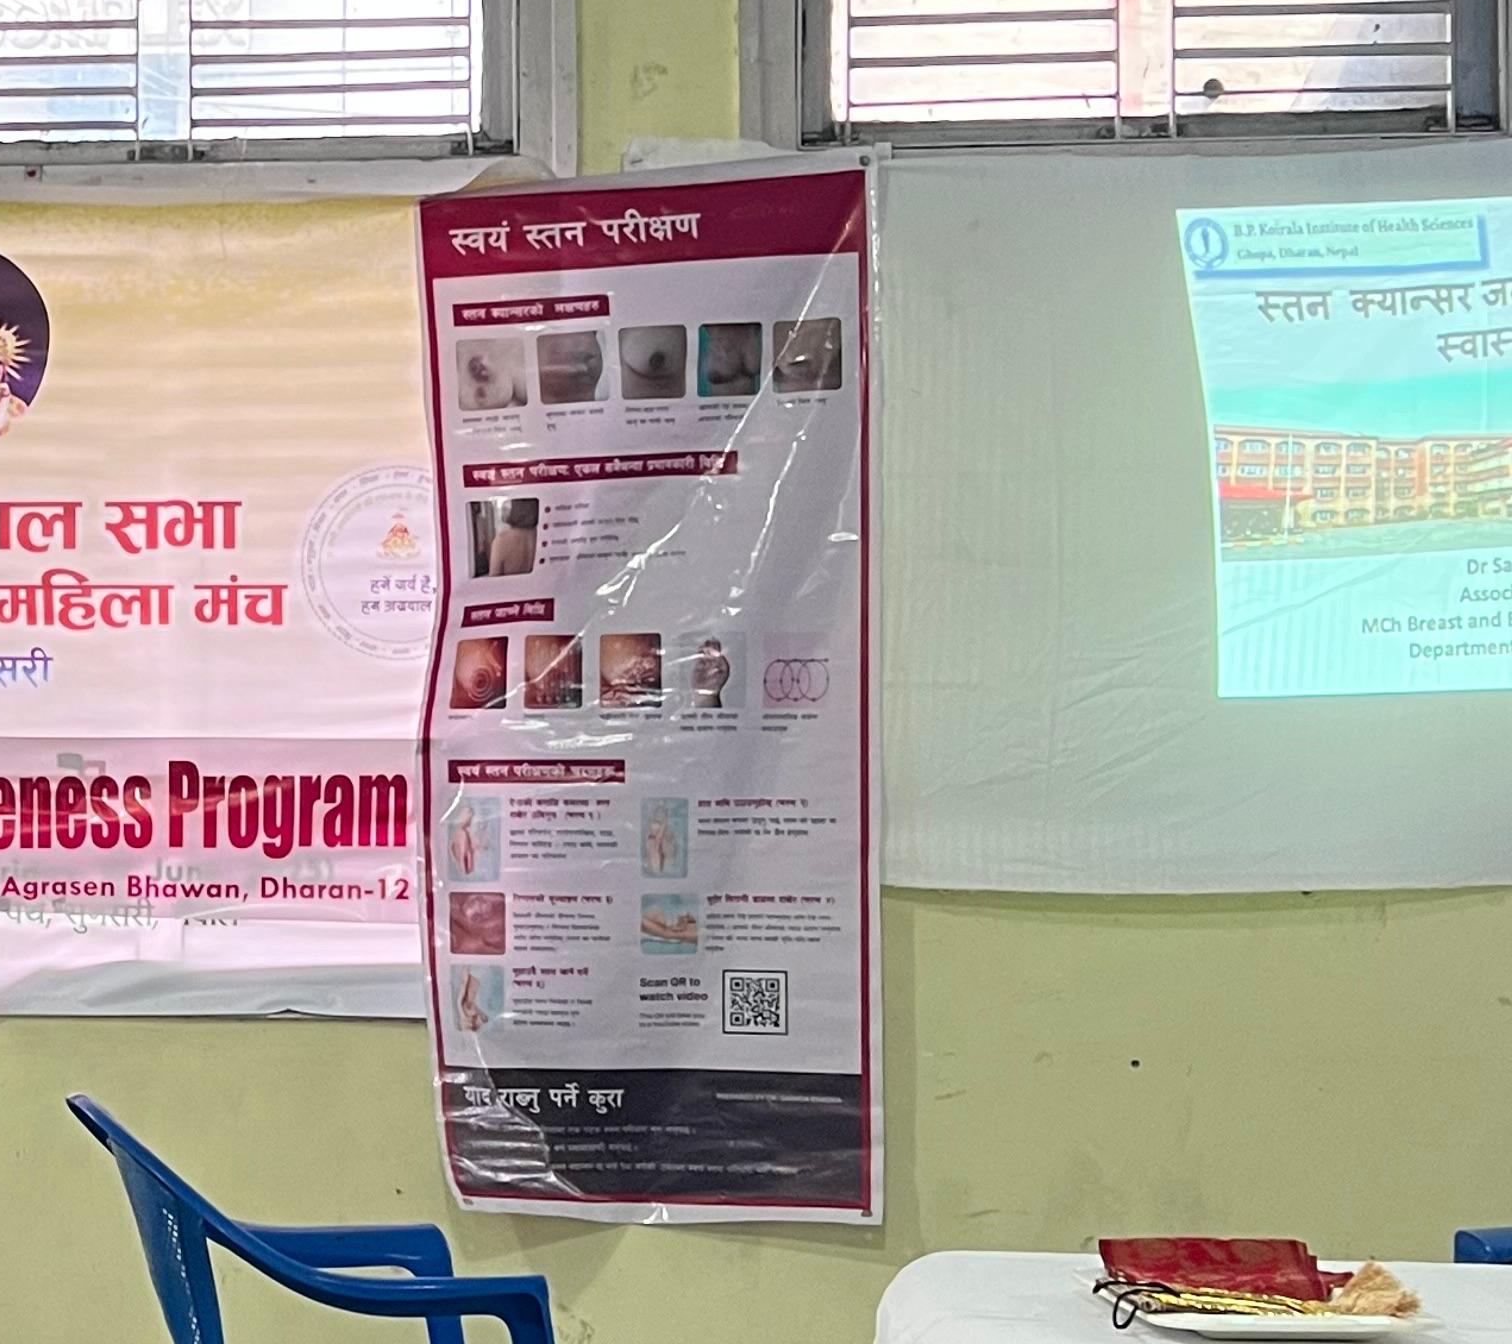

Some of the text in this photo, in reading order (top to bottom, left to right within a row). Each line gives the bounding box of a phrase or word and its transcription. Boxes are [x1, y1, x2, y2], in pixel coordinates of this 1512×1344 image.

[450, 208, 701, 256] स्वयं स्तन परीक्षण
[1363, 218, 1376, 233] of
[1378, 218, 1418, 234] Health
[1421, 217, 1473, 231] Sciences
[1255, 277, 1512, 323] स्तन क्यान्सर ज
[105, 500, 242, 554] सभा
[1467, 558, 1489, 575] Dr
[194, 574, 288, 628] मंच
[1362, 617, 1402, 634] MCh
[1408, 614, 1463, 632] Breast
[1468, 611, 1502, 629] and
[168, 759, 408, 860] Program
[1, 877, 116, 904] Agrasen
[127, 875, 249, 903] Bhawan,
[260, 877, 410, 901] Dharan-12
[670, 977, 687, 987] QR
[689, 977, 701, 987] to
[548, 1082, 580, 1108] पर्ने
[587, 1089, 625, 1114] कुरा
